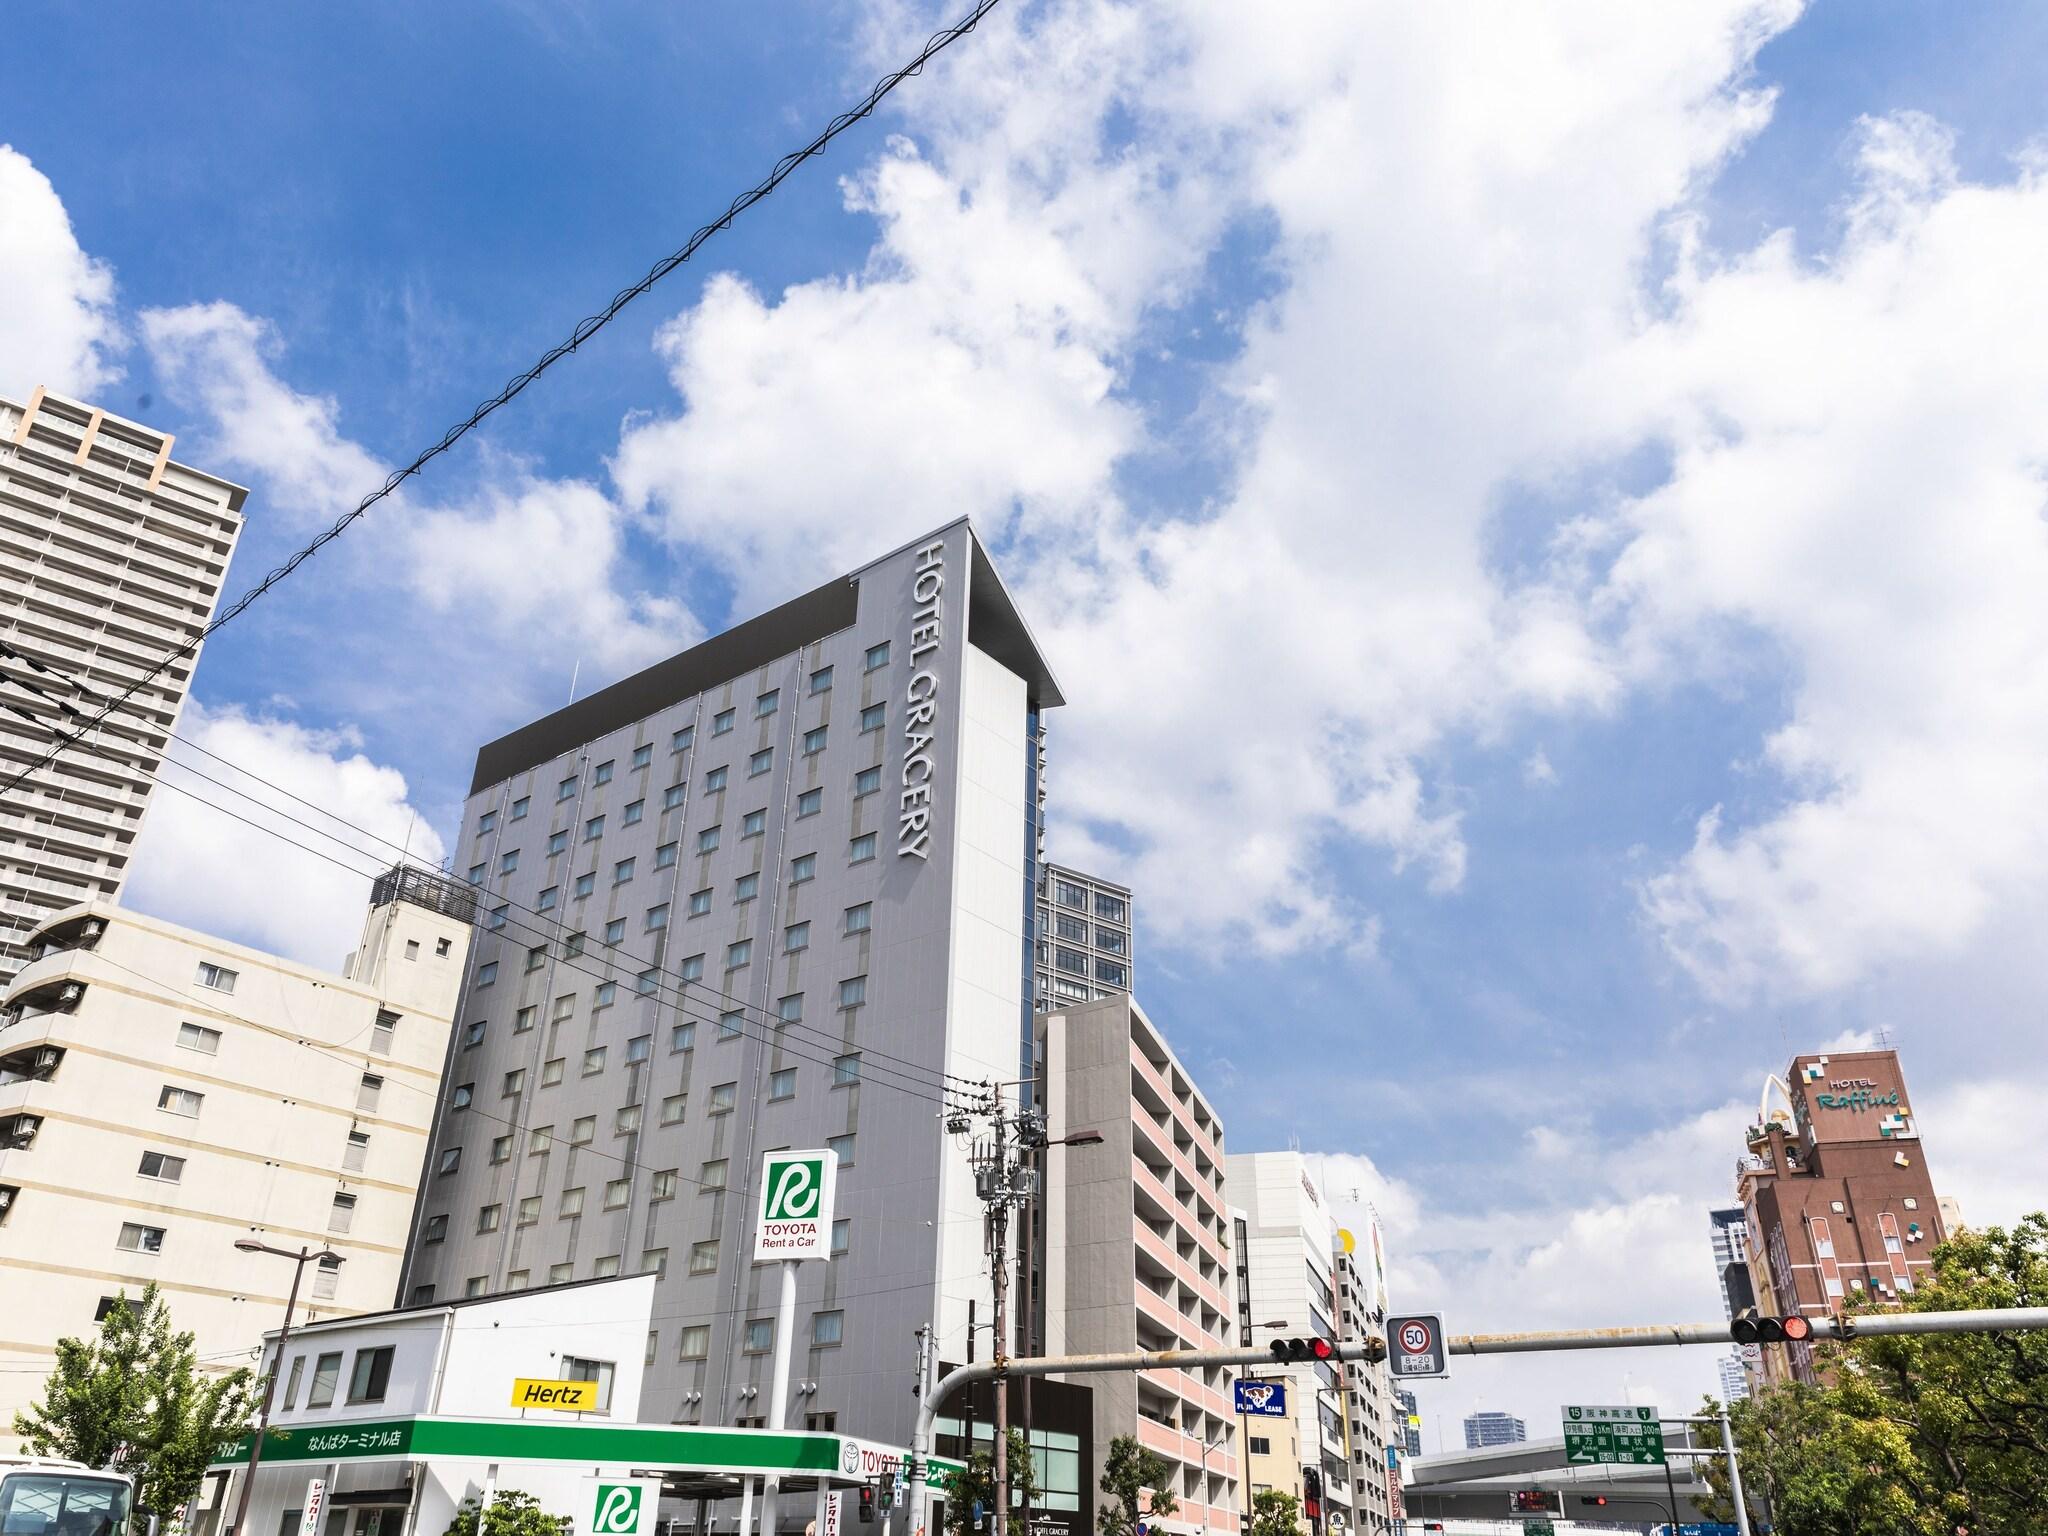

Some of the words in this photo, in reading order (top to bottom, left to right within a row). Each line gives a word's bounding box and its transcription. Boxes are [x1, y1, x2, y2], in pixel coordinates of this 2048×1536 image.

[908, 539, 944, 669] HOTEL
[897, 670, 939, 860] GRACERY
[1829, 1078, 1878, 1089] HOTEL
[1816, 1088, 1899, 1114] Raffiné
[764, 1223, 817, 1236] TOYOTA
[762, 1237, 786, 1248] Rent
[788, 1240, 795, 1248] a
[797, 1236, 816, 1248] Car
[1405, 1330, 1424, 1345] 50
[524, 1384, 583, 1404] Hertz
[1264, 1405, 1283, 1413] LEASE
[1570, 1408, 1581, 1417] 15
[1586, 1408, 1633, 1418] 阪神高速
[308, 1430, 402, 1451] なんばターミナル店
[1620, 1437, 1656, 1446] 環状線
[862, 1450, 900, 1474] TOYOTA
[309, 1483, 323, 1522] レンタカー
[826, 1494, 837, 1532] レンタカー
